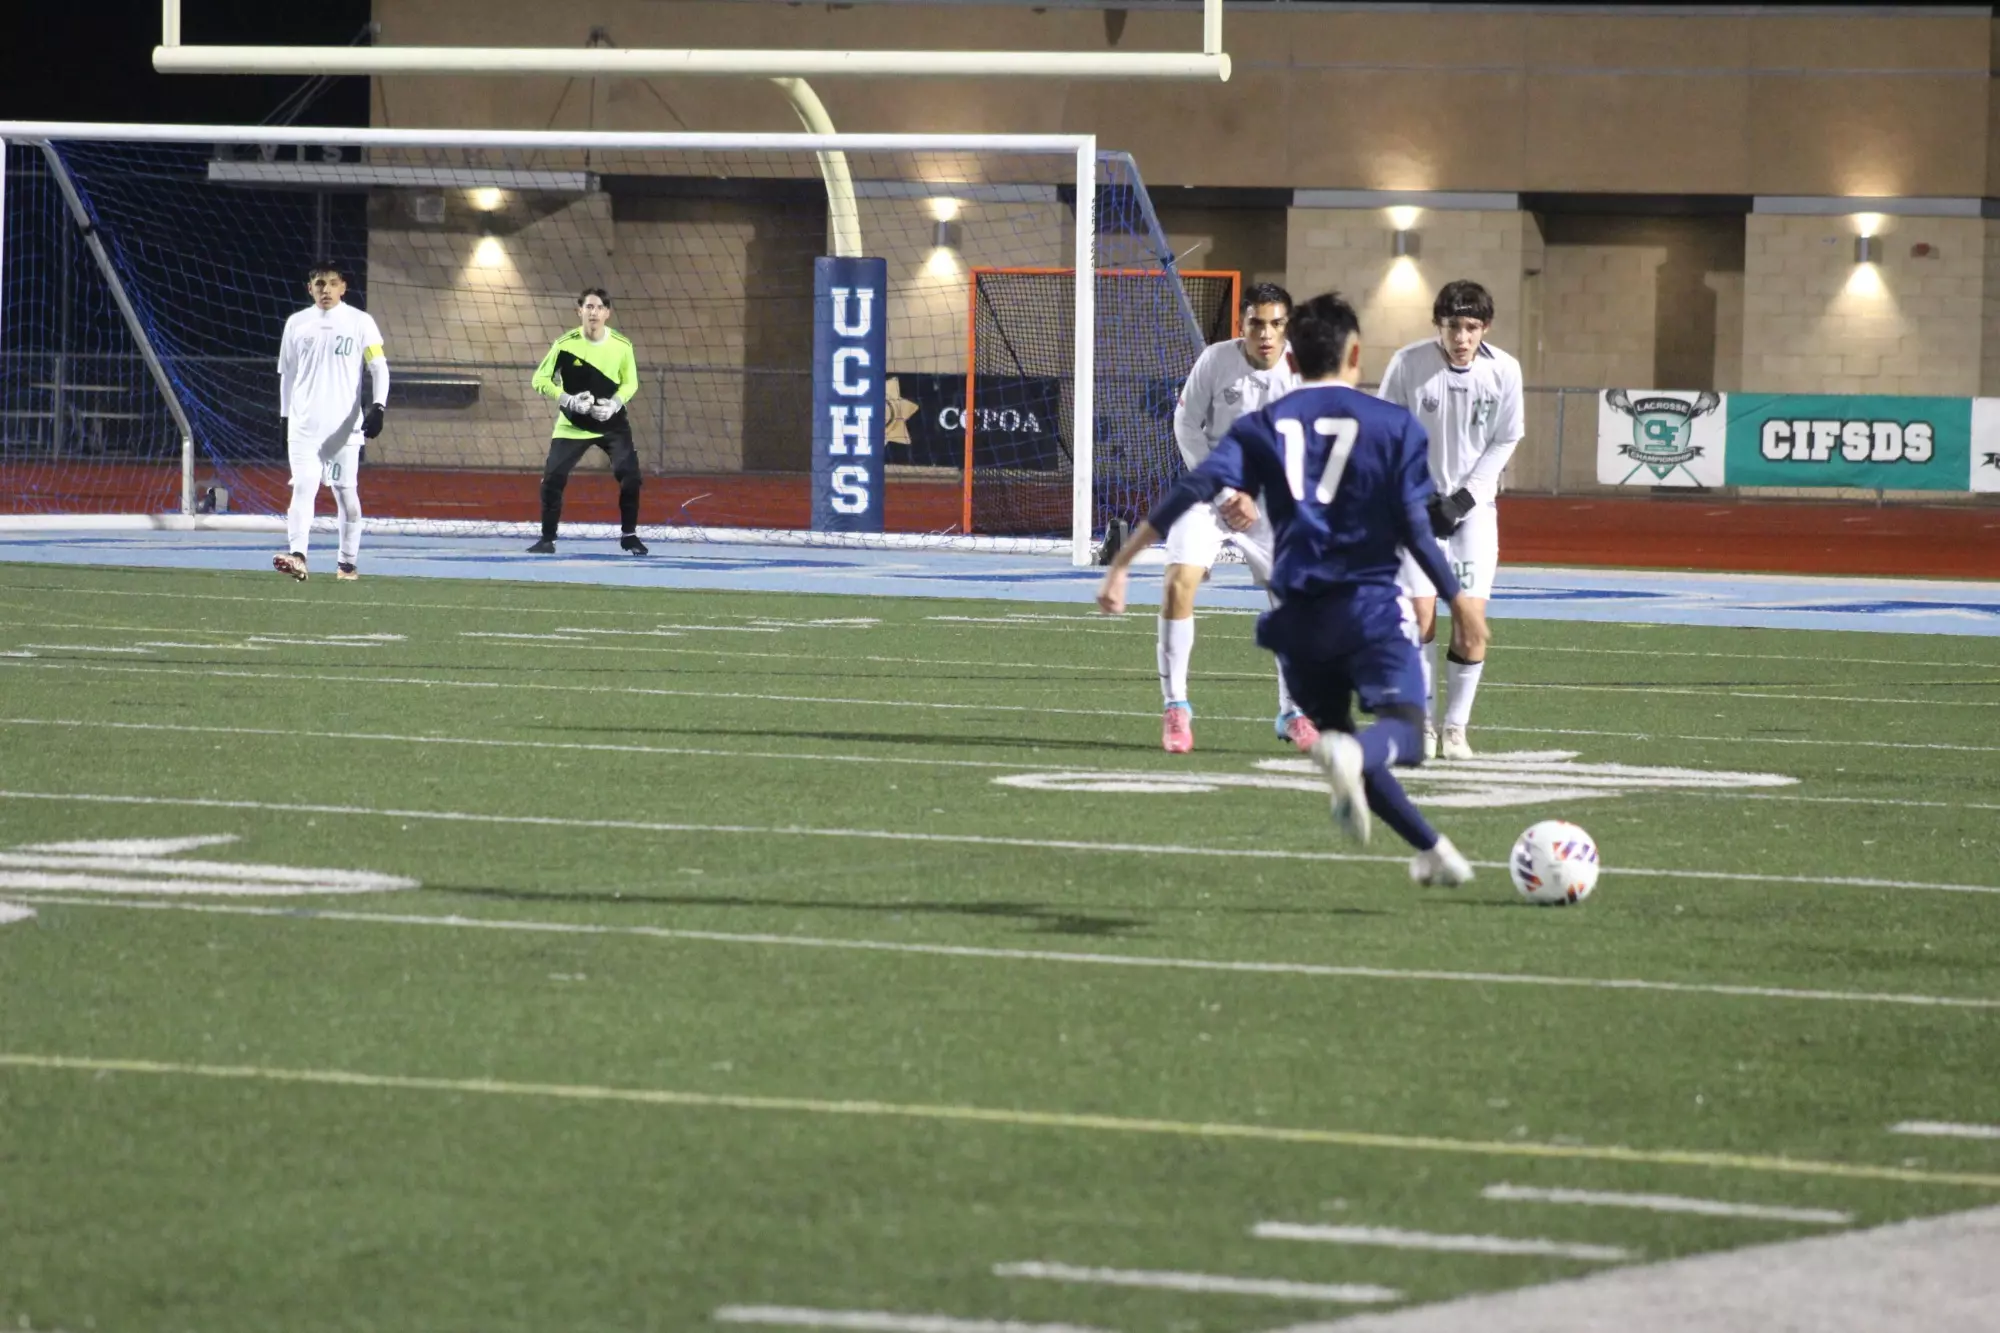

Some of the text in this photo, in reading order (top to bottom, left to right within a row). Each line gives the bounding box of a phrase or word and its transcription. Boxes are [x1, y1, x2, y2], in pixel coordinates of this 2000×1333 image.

[334, 335, 354, 357] 20
[829, 287, 874, 514] UCHS
[1637, 401, 1688, 412] LACROSSE
[1629, 451, 1694, 463] CHAMPIONSHIP
[1760, 418, 1935, 464] CIFSDS
[1275, 417, 1359, 505] 17
